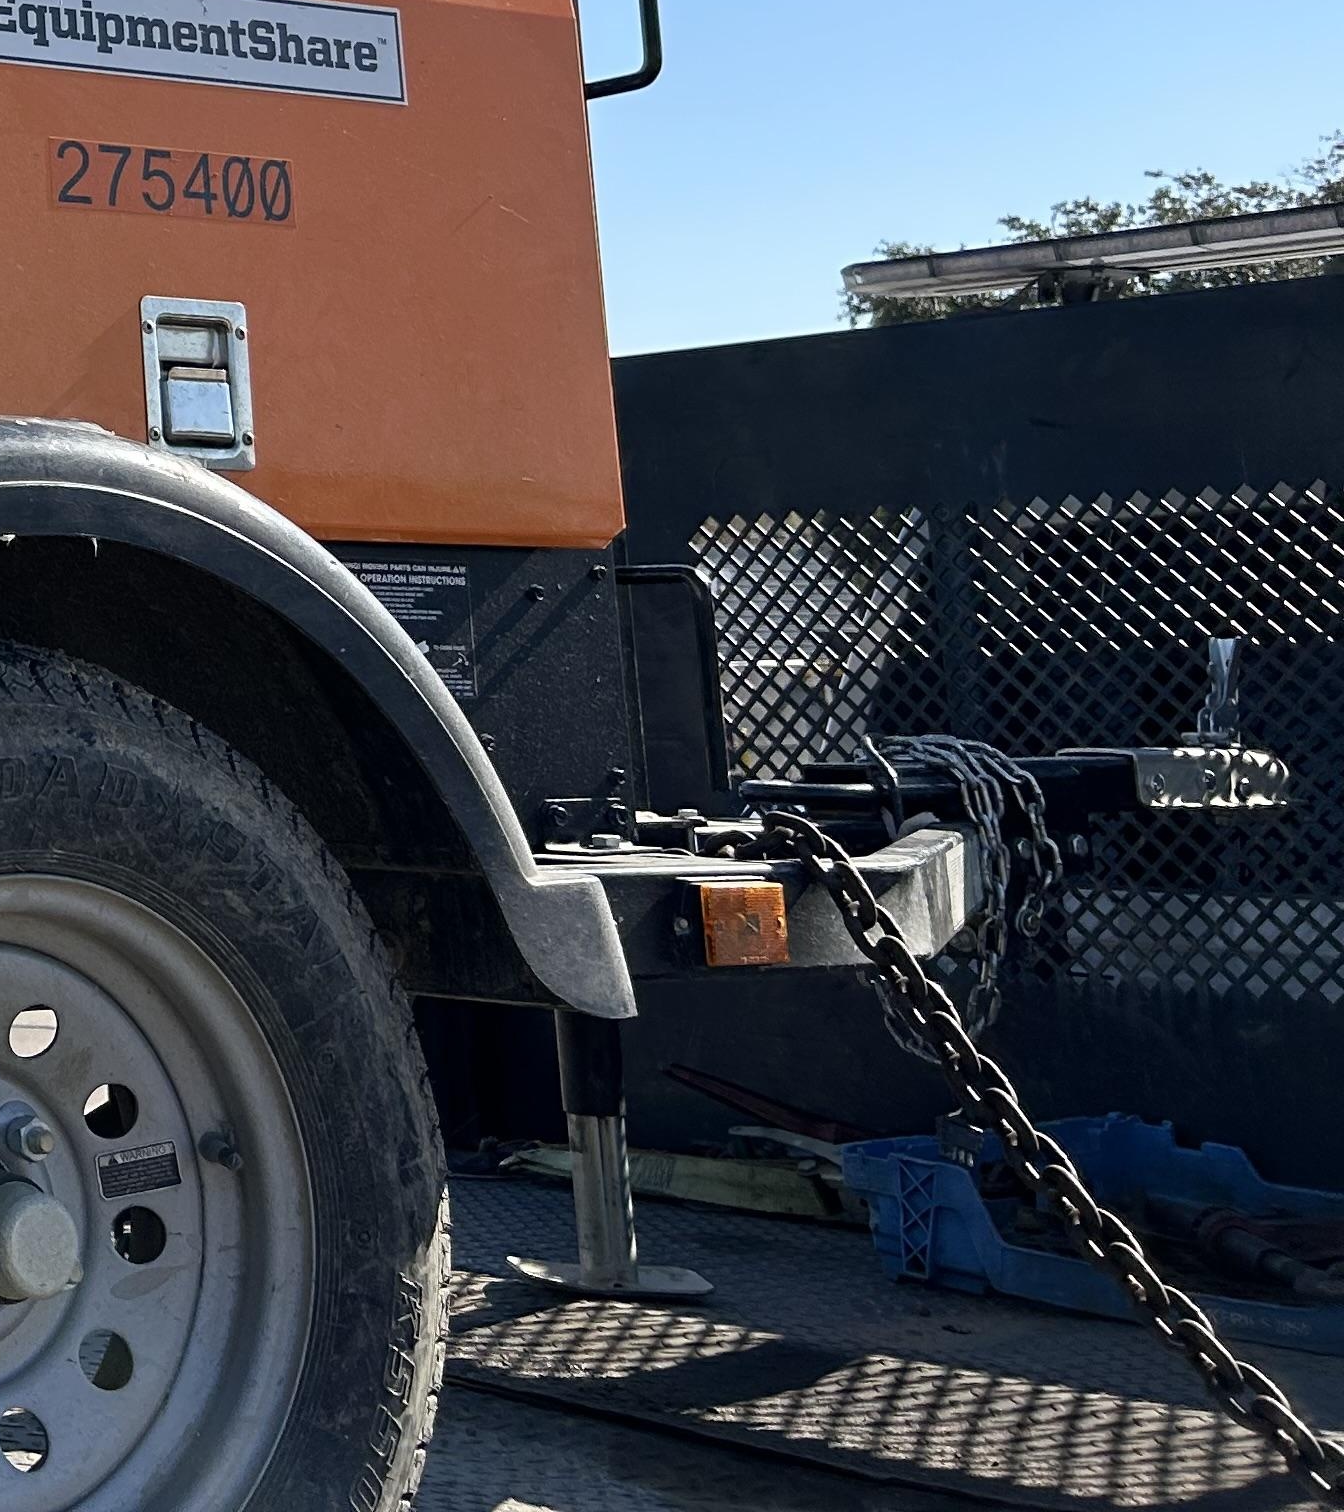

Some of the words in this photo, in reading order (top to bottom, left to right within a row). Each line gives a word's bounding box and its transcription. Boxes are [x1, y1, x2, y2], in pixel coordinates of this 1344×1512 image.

[57, 140, 294, 222] 275400
[360, 573, 407, 585] OPERATION
[120, 1144, 167, 1162] WARNING
